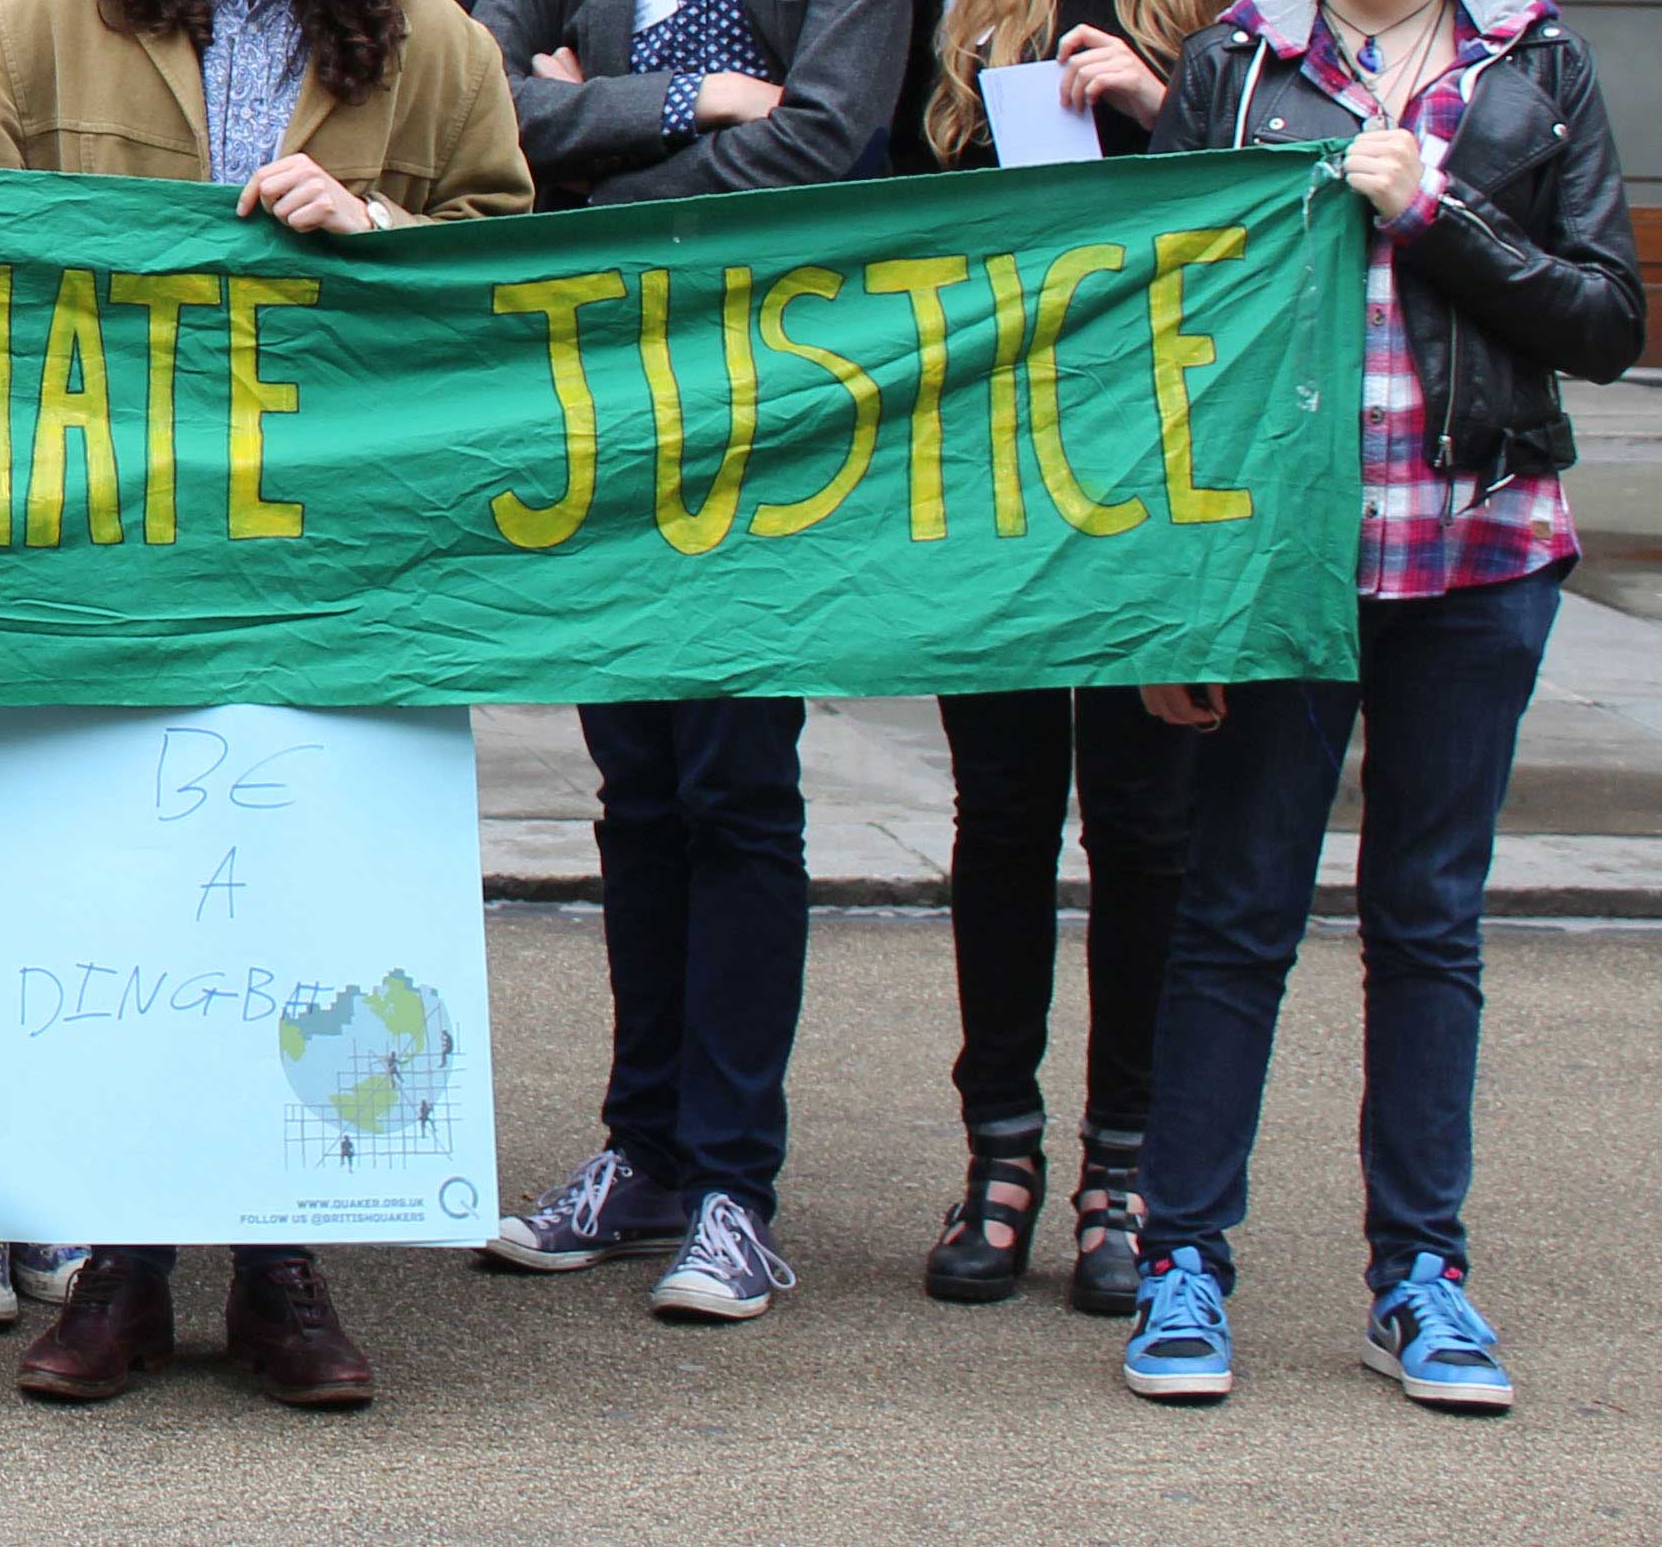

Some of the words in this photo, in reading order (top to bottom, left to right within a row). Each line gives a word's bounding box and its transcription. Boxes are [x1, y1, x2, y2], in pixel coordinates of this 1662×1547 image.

[489, 226, 1253, 556] JUSTICE
[155, 727, 325, 822] BE
[195, 845, 247, 922] A
[240, 1213, 289, 1225] FOLLOW
[291, 1213, 308, 1224] US
[311, 1211, 426, 1226] @BRITISHQUAKERS
[296, 1197, 425, 1210] WWW.QUAKER.ORG.UK
